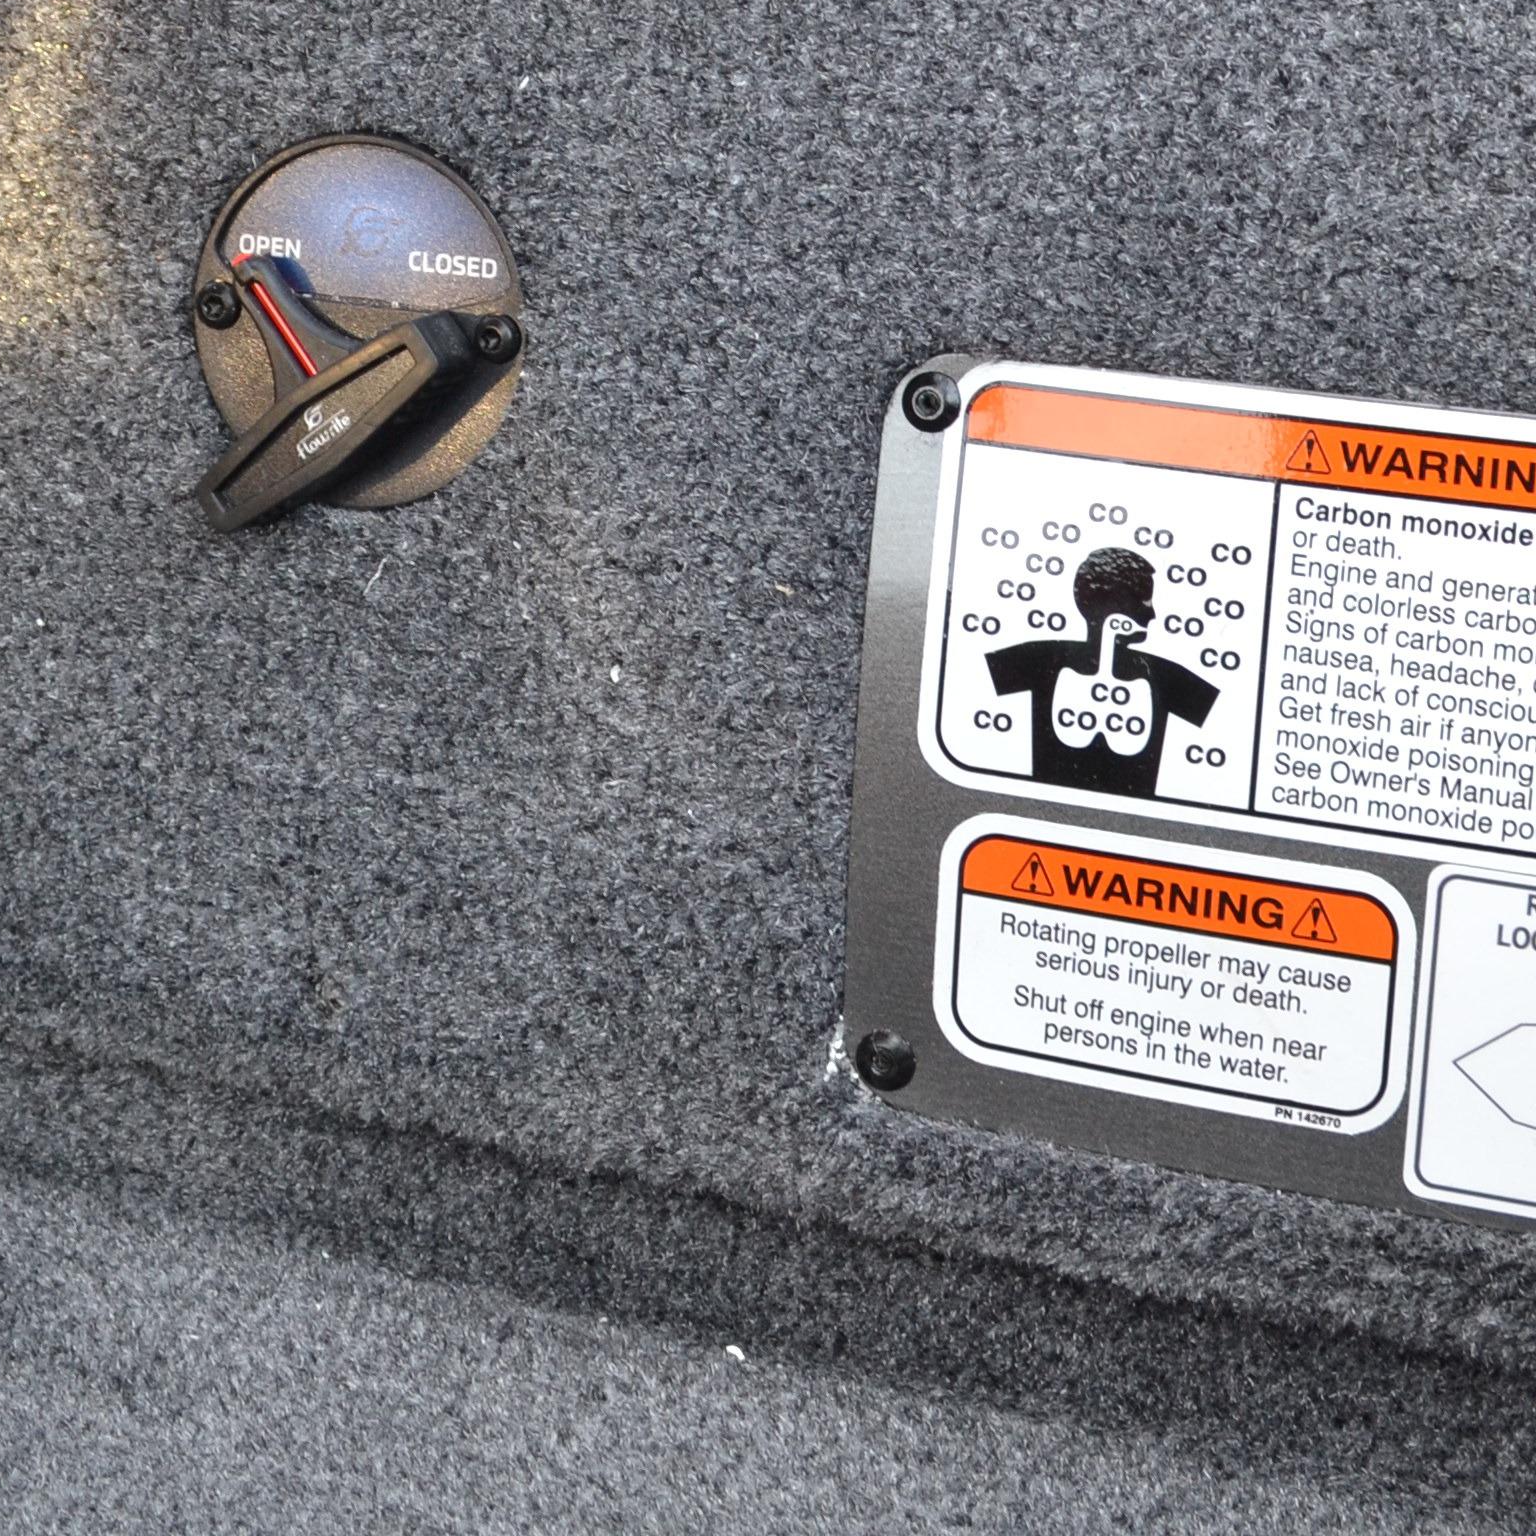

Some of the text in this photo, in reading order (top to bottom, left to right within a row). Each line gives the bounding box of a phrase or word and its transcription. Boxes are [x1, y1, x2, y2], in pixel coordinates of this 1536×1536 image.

[238, 233, 302, 259] OPEN
[407, 250, 498, 279] CLOSED
[1089, 503, 1128, 525] CO
[1295, 496, 1392, 530] Carbon
[1401, 514, 1534, 547] monoxide
[981, 528, 1019, 549] CO
[1042, 521, 1080, 543] CO
[1134, 527, 1174, 548] CO
[1292, 530, 1402, 560] or death.
[1026, 554, 1064, 575] CO
[1211, 544, 1251, 565] CO
[1167, 565, 1207, 586] CO
[1290, 552, 1377, 590] Engine
[1385, 570, 1433, 593] and
[997, 580, 1035, 601] CO
[1204, 598, 1244, 619] CO
[1287, 585, 1334, 609] and
[1342, 593, 1456, 625] colorless
[963, 614, 1000, 635] CO
[1027, 610, 1066, 631] CO
[1110, 619, 1132, 632] CO
[1164, 614, 1204, 636] CO
[1285, 609, 1355, 643] Signs
[1363, 622, 1388, 645] of
[1395, 629, 1484, 658] carbon
[1200, 648, 1240, 670] CO
[1283, 644, 1379, 675] nausea,
[1390, 653, 1522, 694] headache,
[1091, 683, 1130, 705] CO
[1279, 672, 1327, 695] and
[1336, 674, 1385, 703] lack
[1394, 684, 1420, 707] of
[973, 710, 1012, 732] CO
[1058, 709, 1145, 735] CO CO
[1278, 695, 1322, 724] Get
[1330, 702, 1391, 732] fresh
[1399, 715, 1432, 738] air
[1439, 717, 1454, 741] if
[1186, 745, 1226, 767] CO
[1276, 729, 1400, 763] monoxide
[1273, 751, 1322, 780] See
[1329, 759, 1431, 796] Owner's
[1439, 775, 1533, 811] Manual
[1271, 785, 1358, 814] carbon
[1366, 799, 1493, 834] monoxide
[1062, 865, 1285, 930] WARNING
[1000, 911, 1352, 993] Rotating propeller may cause
[1035, 950, 1307, 1014] serious injury or death.
[1013, 983, 1327, 1061] Shut off engine when near
[1043, 1022, 1288, 1083] persons in the water.
[1274, 1105, 1342, 1129] PN 142670
